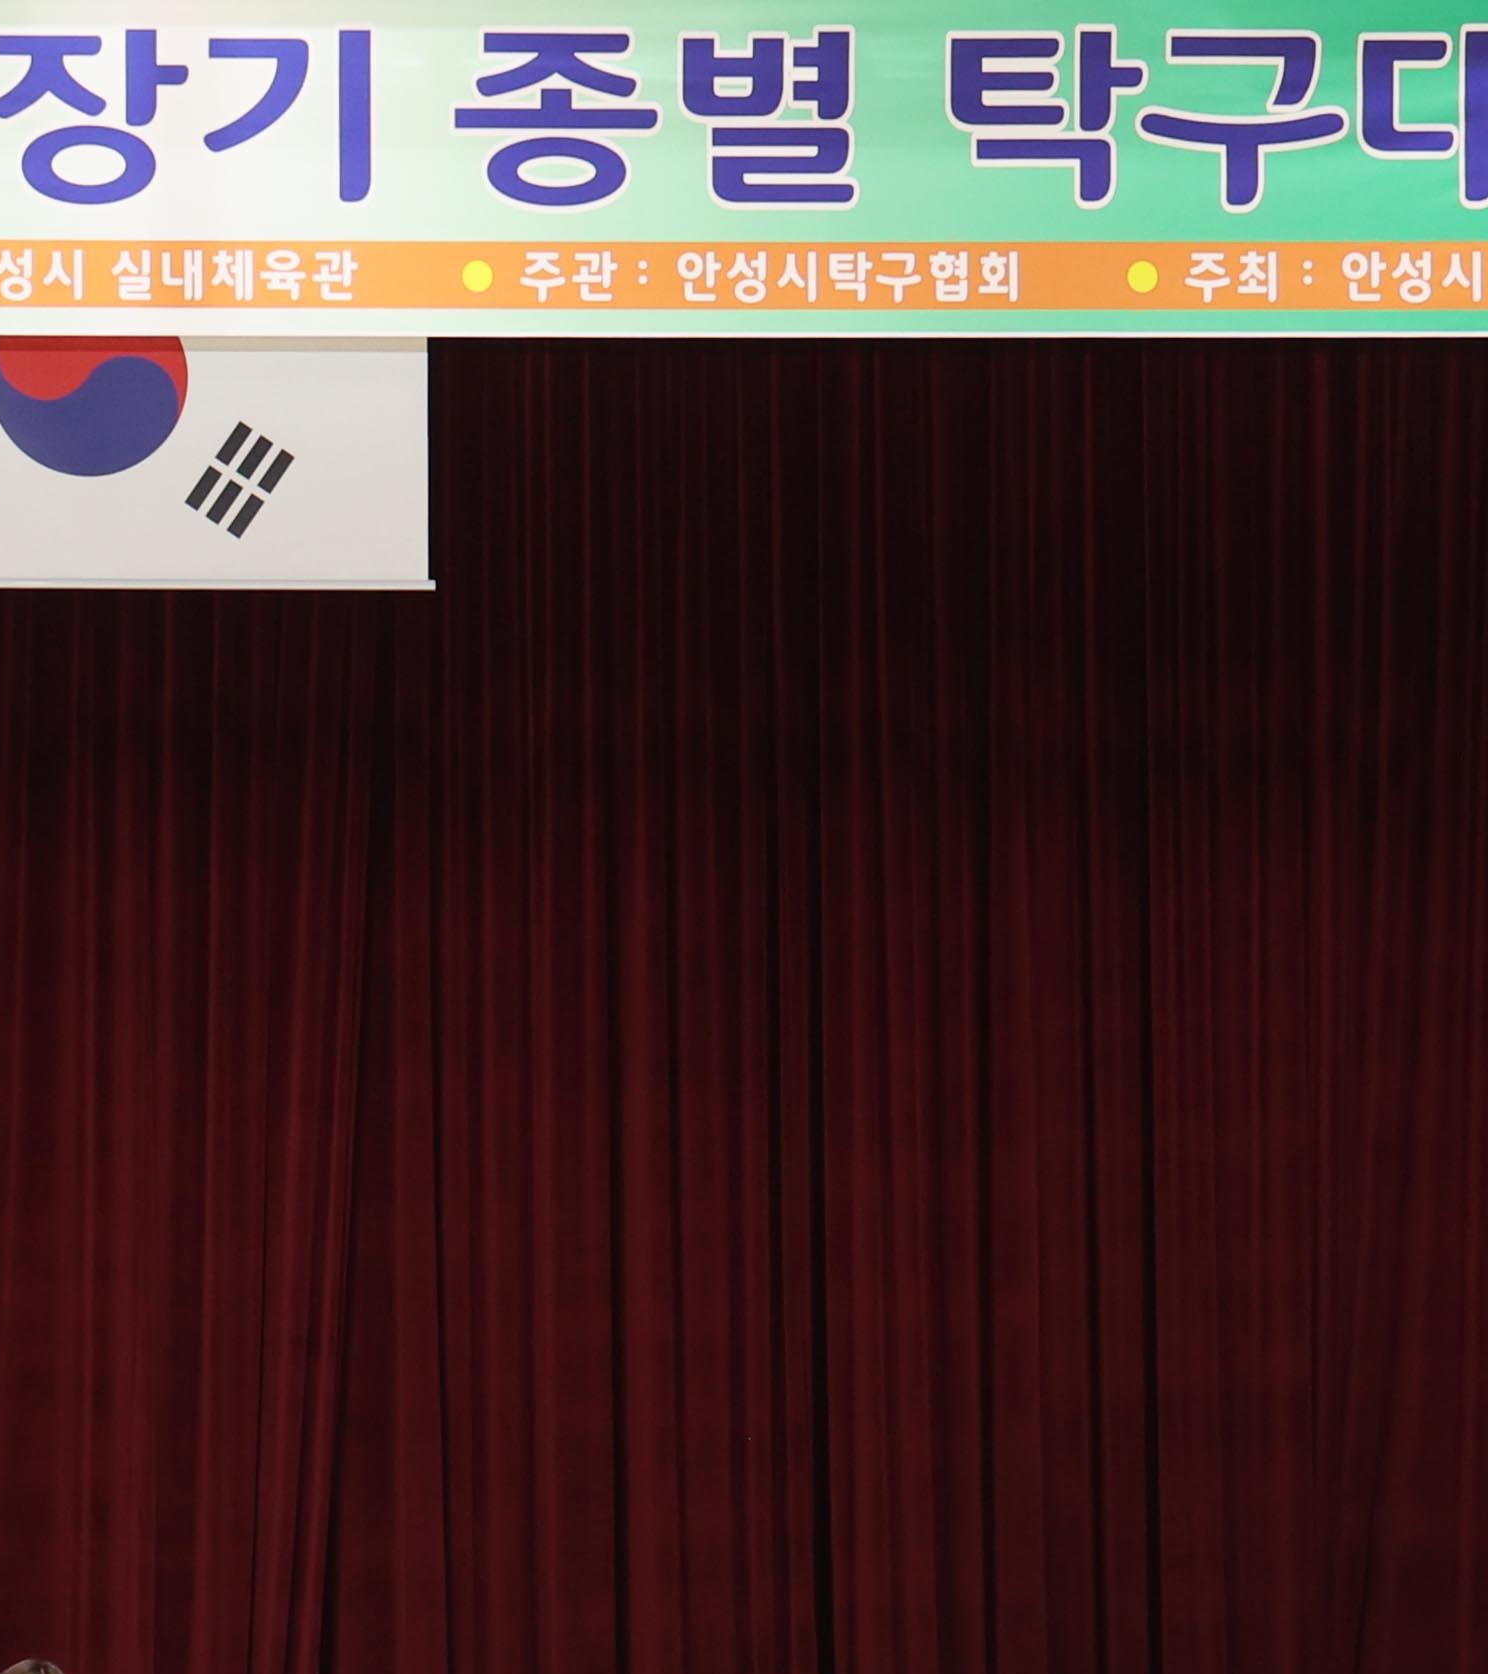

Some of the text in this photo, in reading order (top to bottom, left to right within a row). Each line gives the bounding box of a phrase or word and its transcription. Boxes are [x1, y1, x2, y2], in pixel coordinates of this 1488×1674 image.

[452, 28, 858, 208] 종별
[111, 250, 359, 303] 실내체육관
[519, 252, 617, 303] 주관
[676, 250, 1022, 304] 안성시탁구협회
[1184, 251, 1279, 303] 주최
[1340, 250, 1484, 303] 안성시
